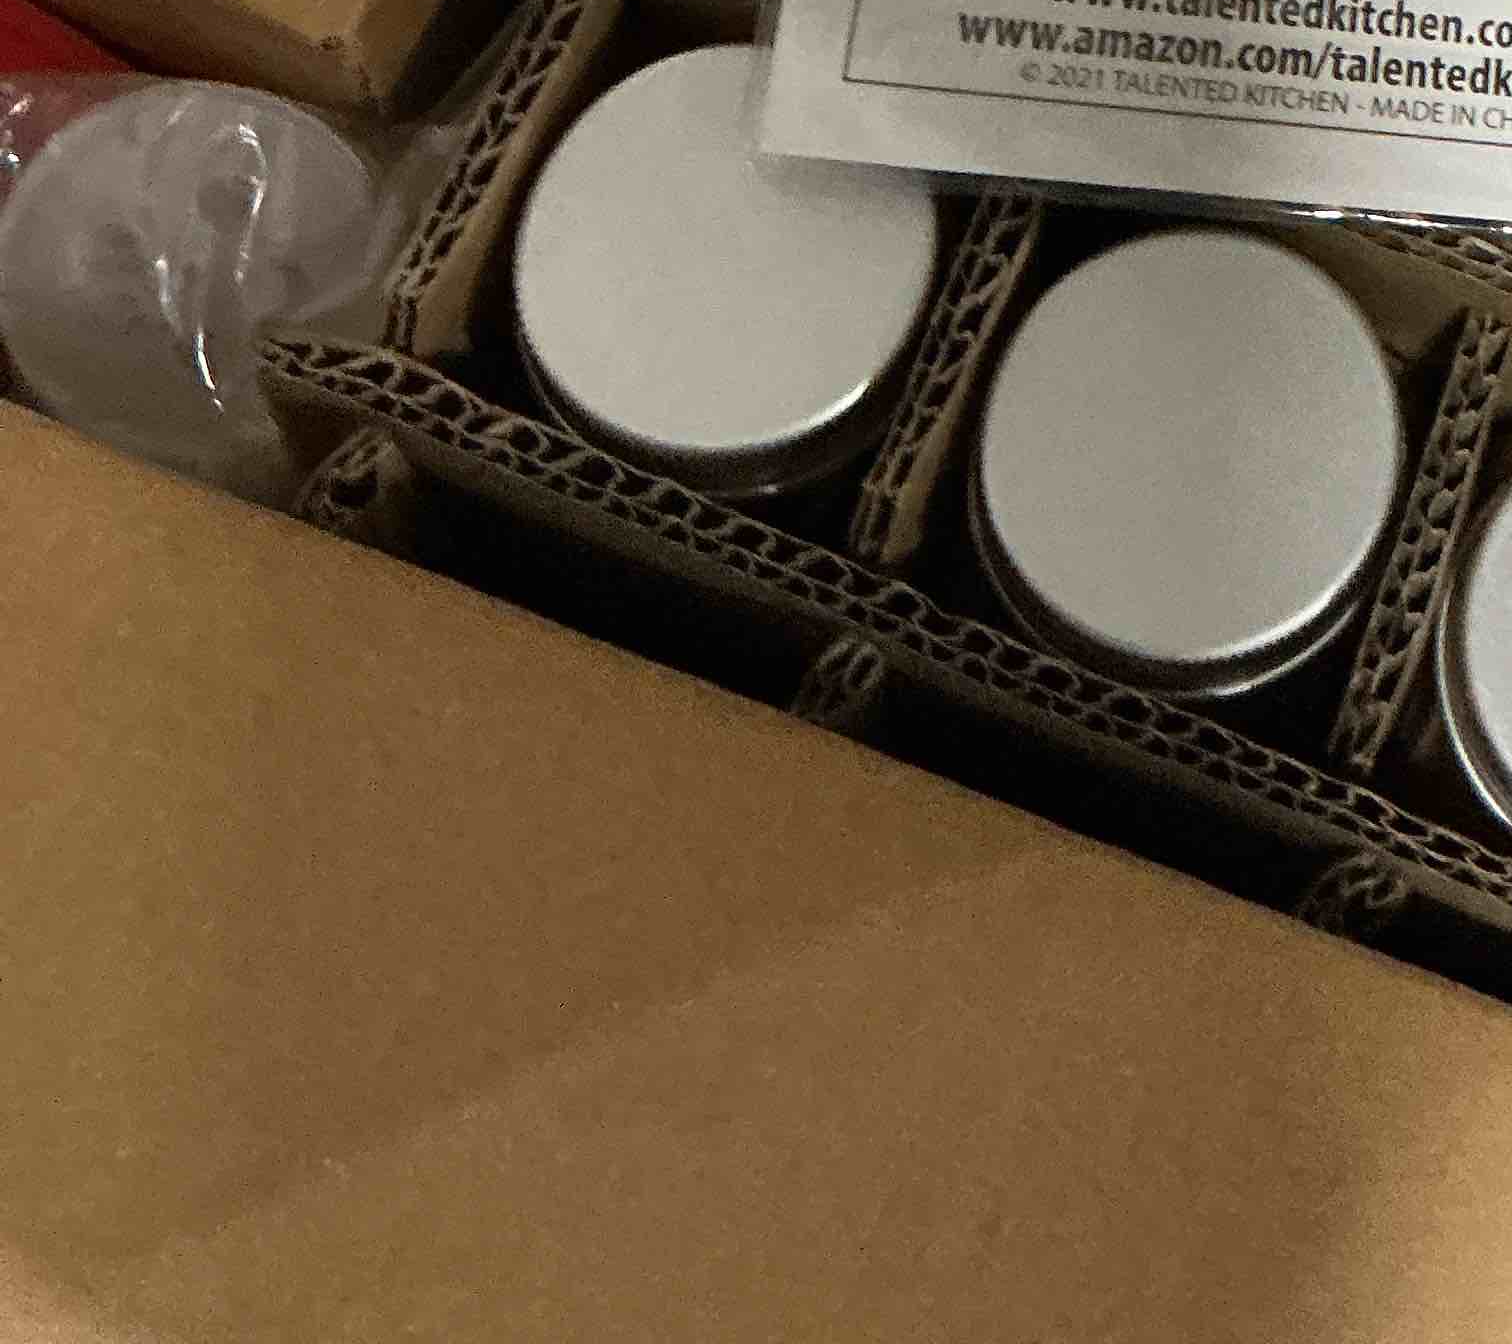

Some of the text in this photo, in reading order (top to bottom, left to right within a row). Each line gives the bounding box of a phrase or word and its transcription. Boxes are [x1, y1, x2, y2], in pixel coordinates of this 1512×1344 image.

[1047, 64, 1104, 91] 2021
[1113, 68, 1238, 104] TALENTED
[1244, 84, 1350, 116] KITCHEN
[1368, 96, 1446, 125] MADE
[1451, 105, 1476, 129] IN
